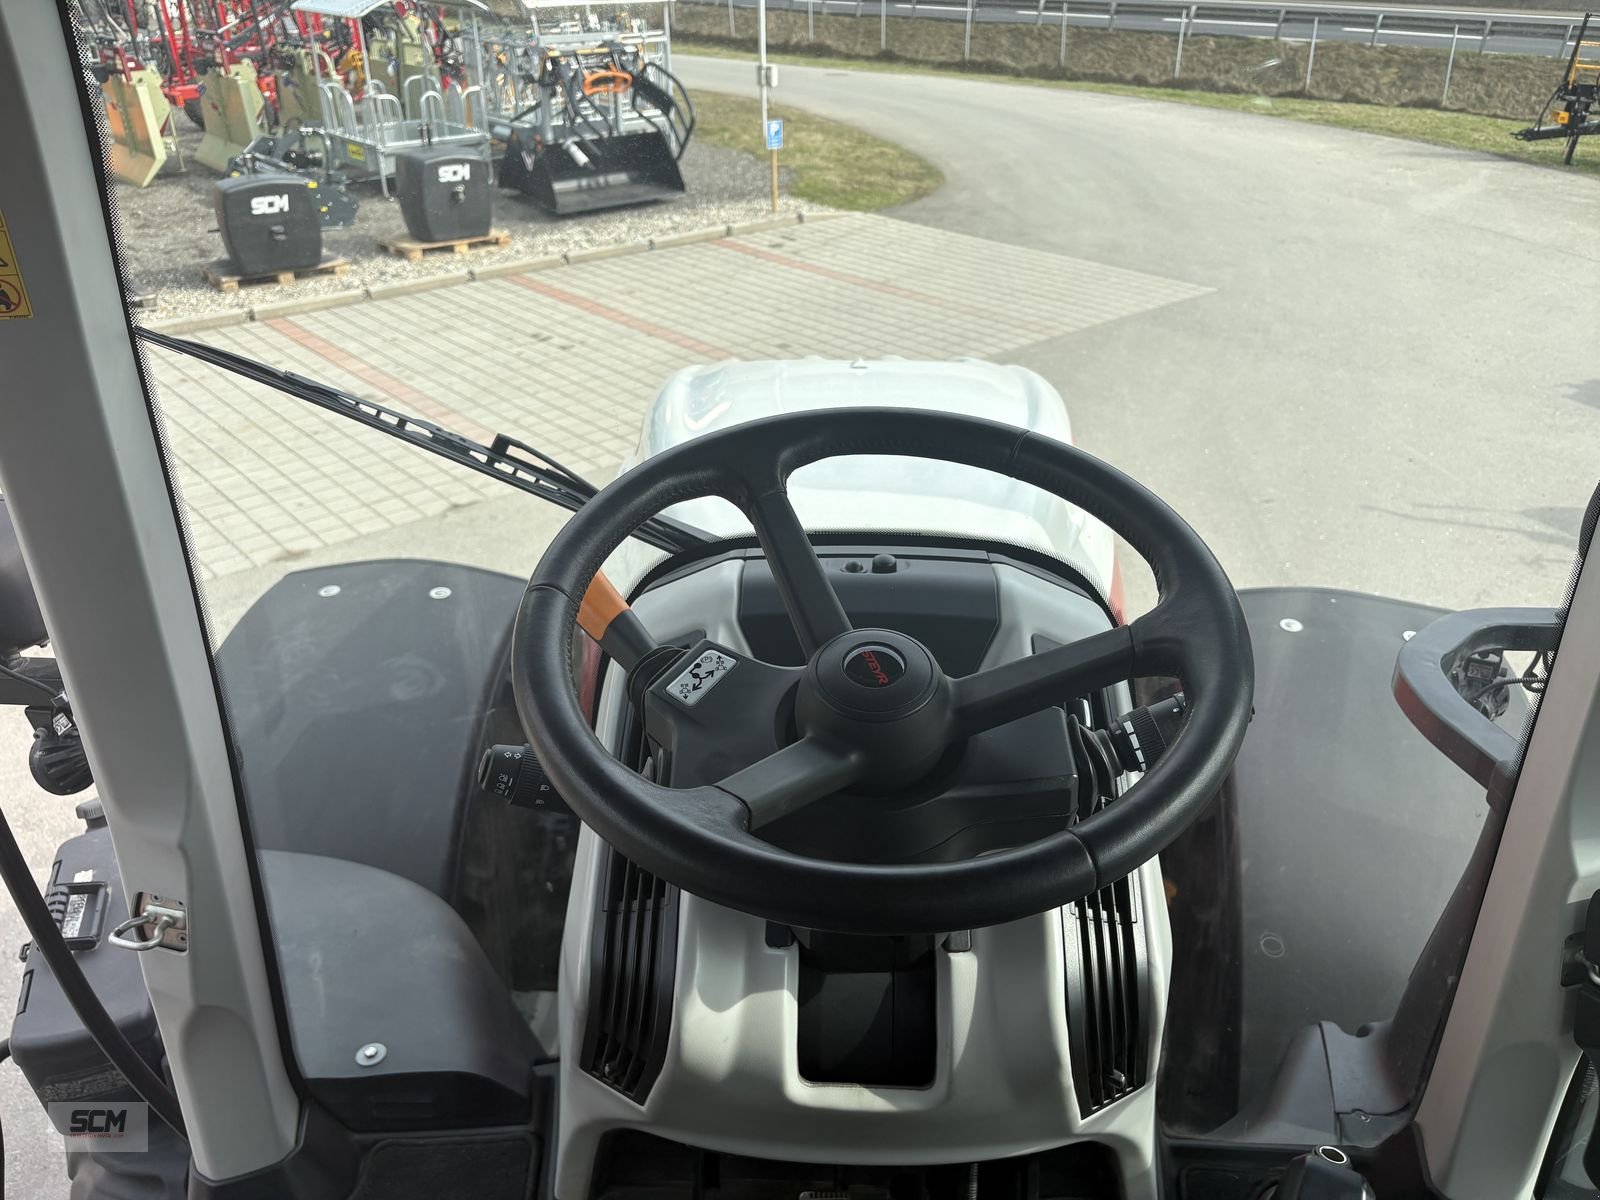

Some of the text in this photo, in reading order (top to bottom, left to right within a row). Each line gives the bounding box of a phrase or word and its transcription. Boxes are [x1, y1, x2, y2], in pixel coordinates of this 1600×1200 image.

[438, 164, 471, 182] SCM
[251, 194, 289, 215] SCM
[862, 650, 888, 684] STEYR
